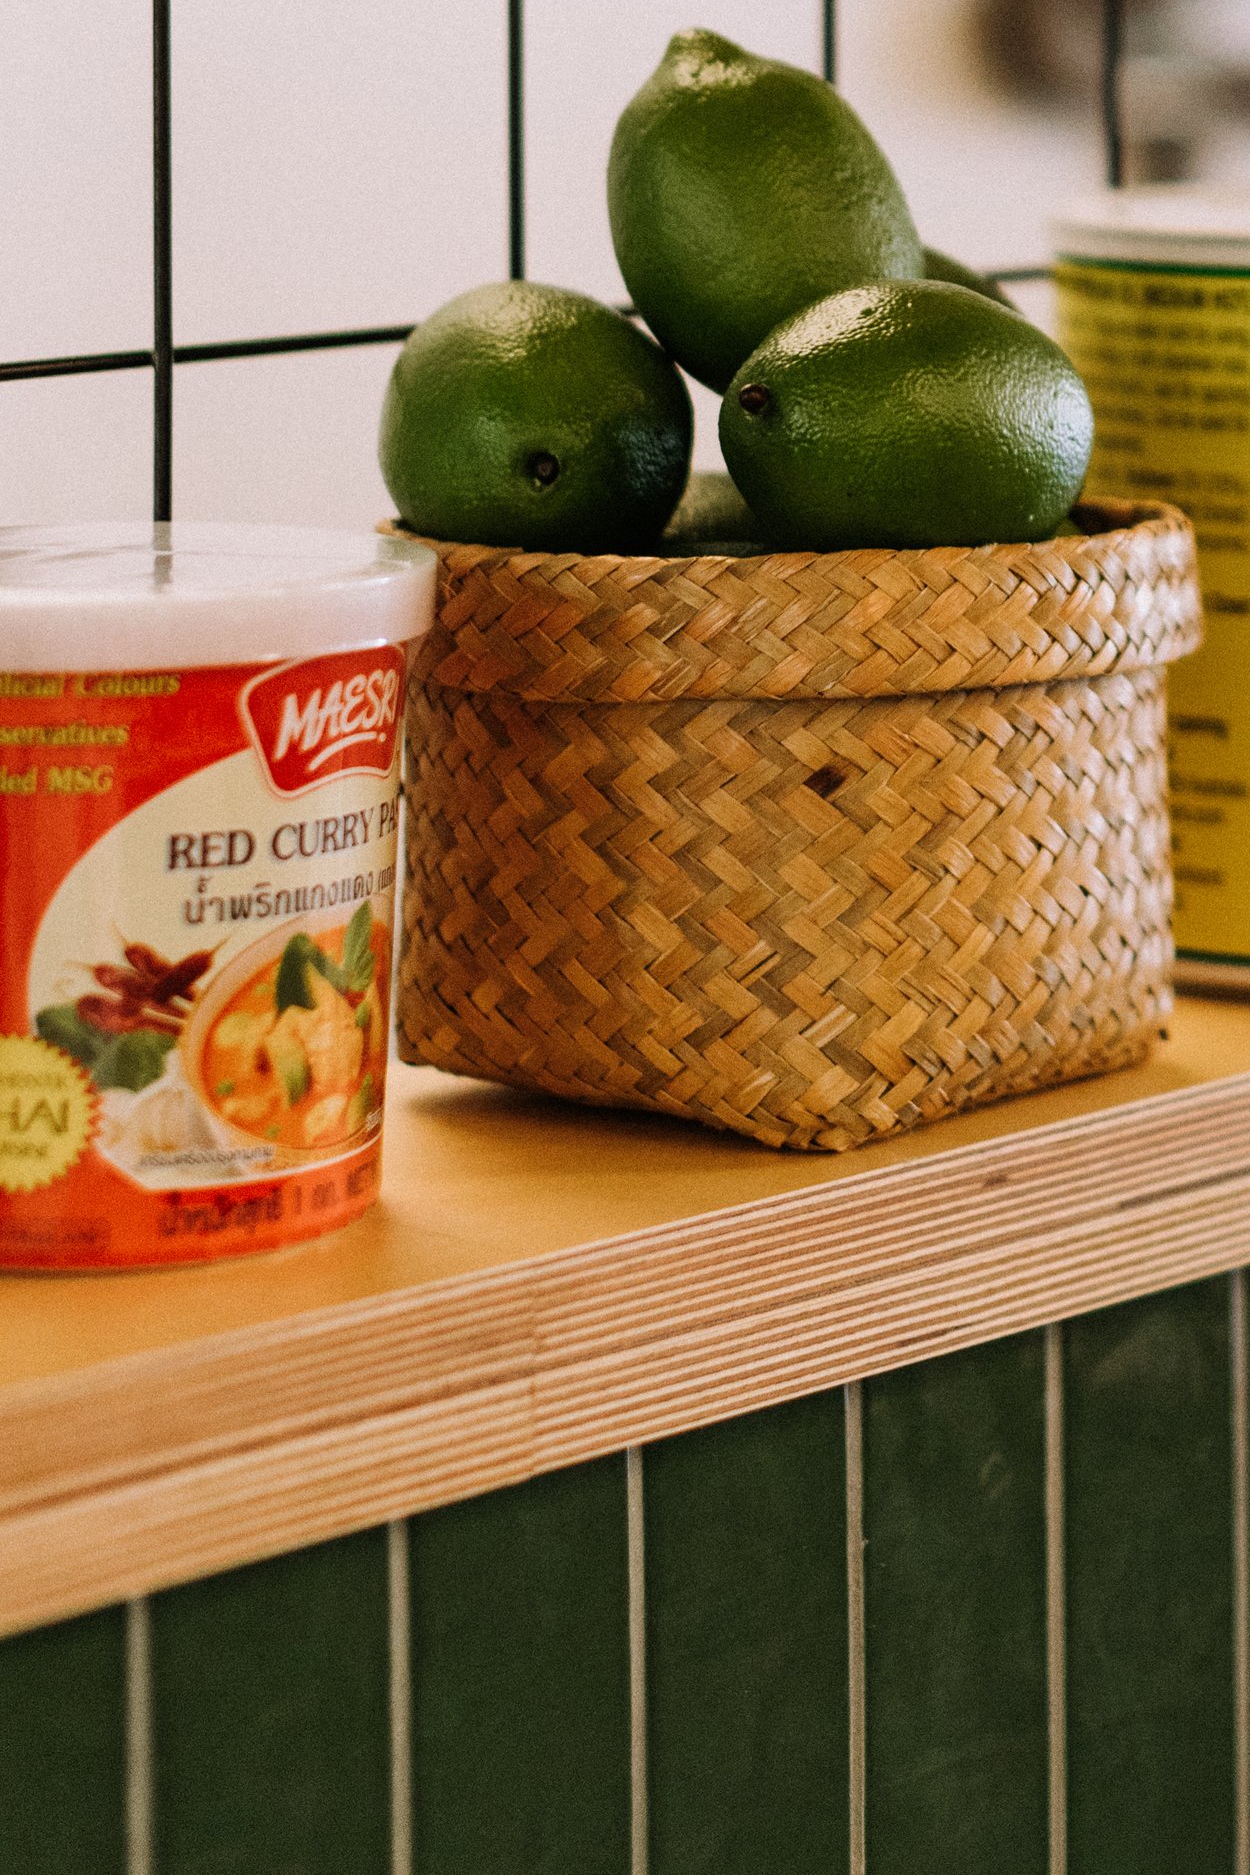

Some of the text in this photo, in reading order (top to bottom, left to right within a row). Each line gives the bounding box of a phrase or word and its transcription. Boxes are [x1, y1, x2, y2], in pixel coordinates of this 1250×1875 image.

[75, 673, 181, 698] Colours
[48, 764, 114, 795] MSG
[168, 829, 256, 872] RED
[271, 807, 374, 862] CURRY
[181, 869, 374, 926] น้ำพริกแกงแดง
